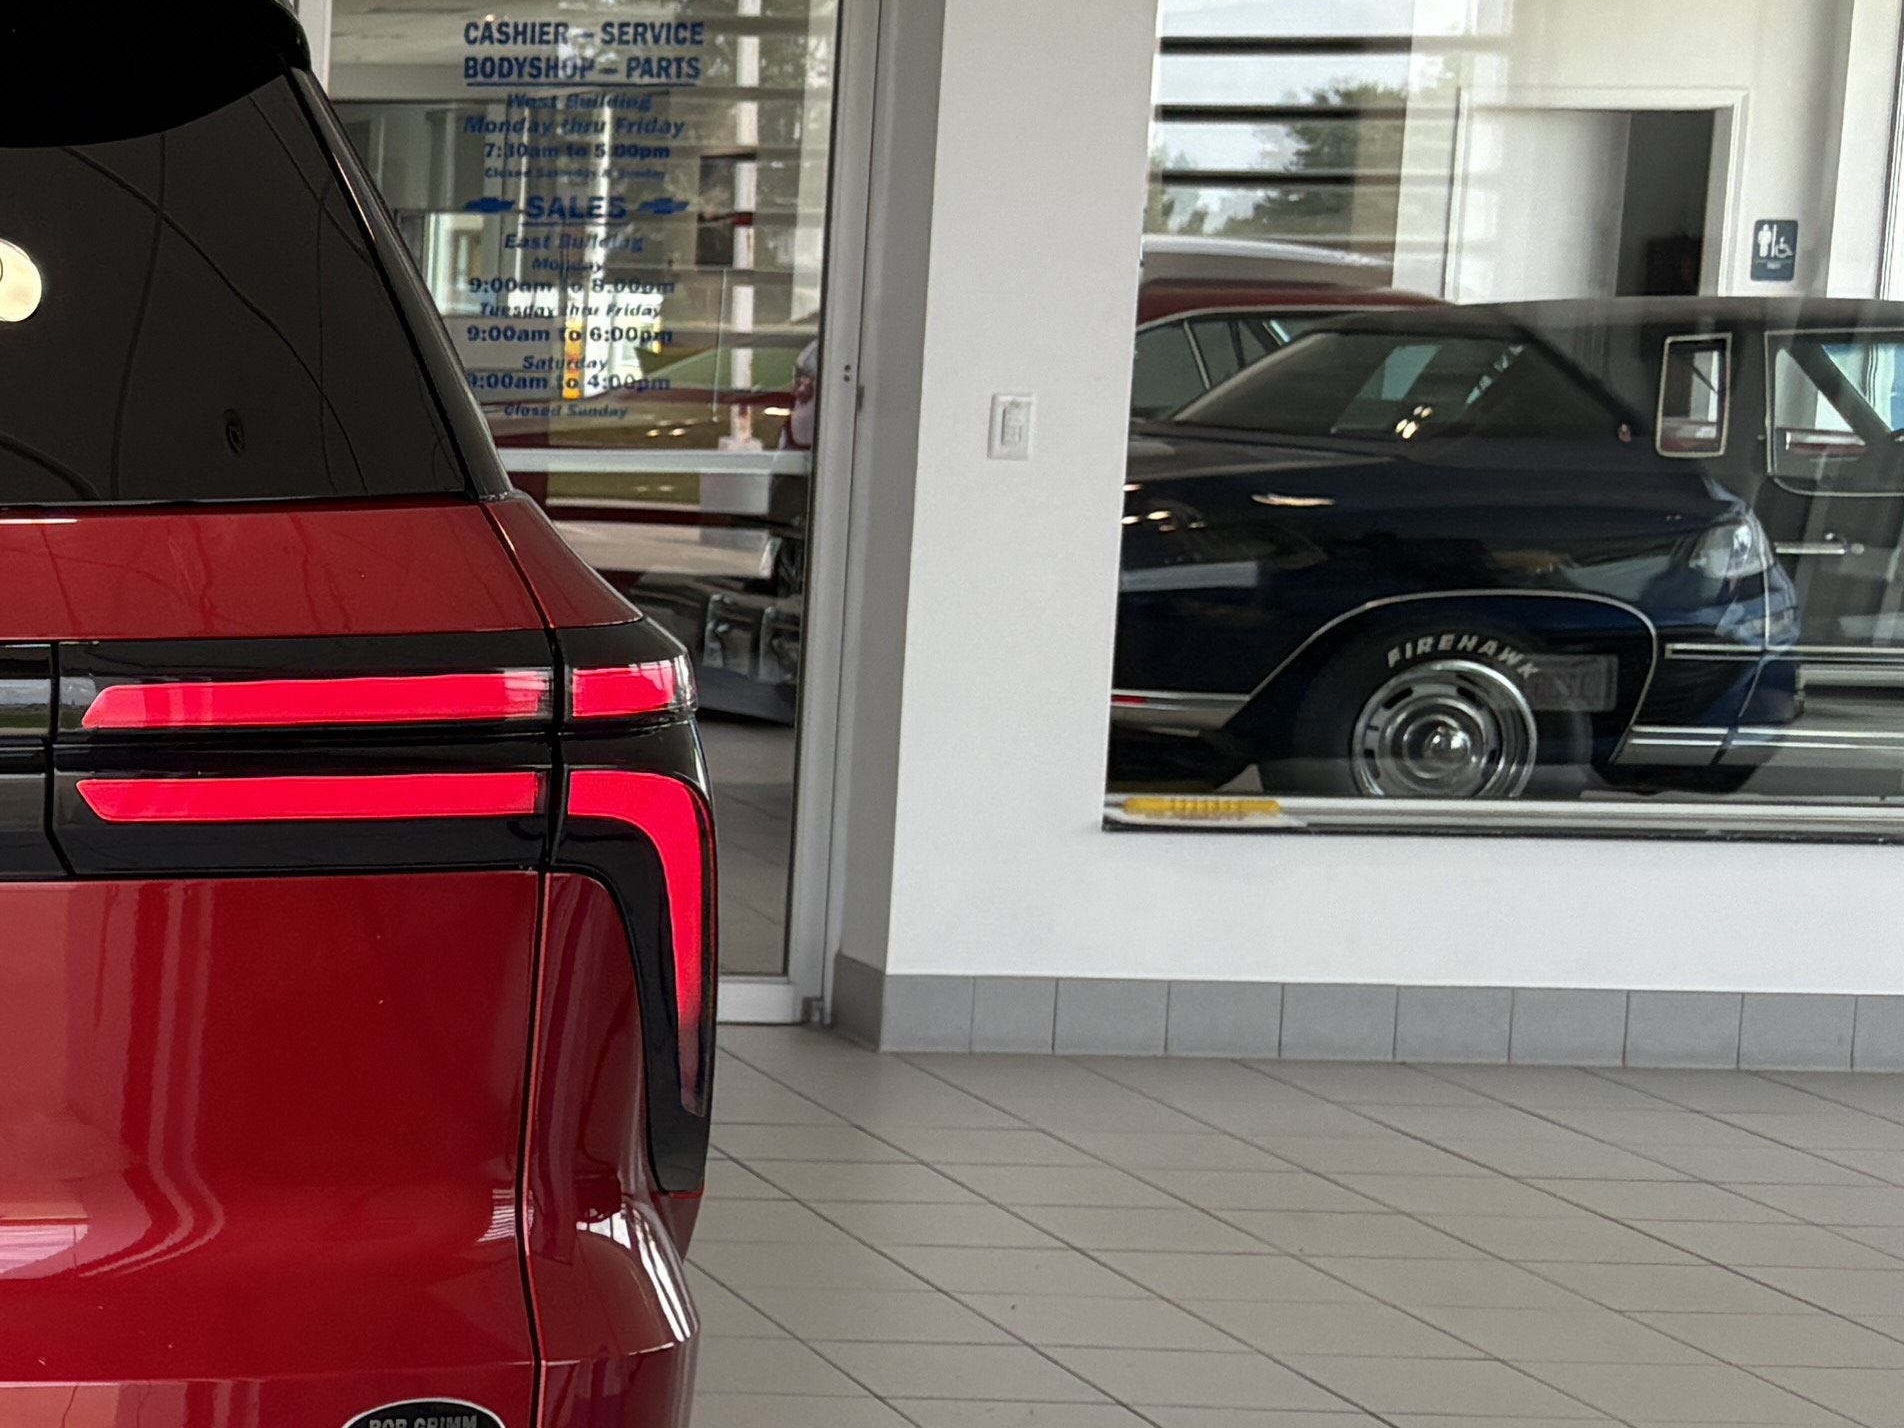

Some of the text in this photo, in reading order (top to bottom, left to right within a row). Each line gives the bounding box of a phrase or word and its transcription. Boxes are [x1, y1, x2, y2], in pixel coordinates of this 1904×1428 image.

[464, 21, 569, 45] CASHIER
[601, 21, 704, 45] SERVICE
[464, 56, 595, 79] BODYSHOP
[626, 56, 701, 79] PARTS
[507, 93, 653, 112] West Building
[464, 117, 685, 137] Monday thru Friday
[567, 143, 587, 158] to
[595, 143, 670, 160] 500pm
[526, 196, 628, 219] SALES
[505, 233, 550, 250] East
[469, 278, 552, 293] 9:00am
[606, 302, 662, 319] Friday
[468, 326, 550, 342] 9:00am
[590, 326, 673, 344] 6:00pm
[523, 355, 608, 372] Saturday
[587, 374, 671, 392] 4:00pm
[504, 404, 628, 418] Closed Sunday
[1387, 633, 1540, 680] FIREHAWK
